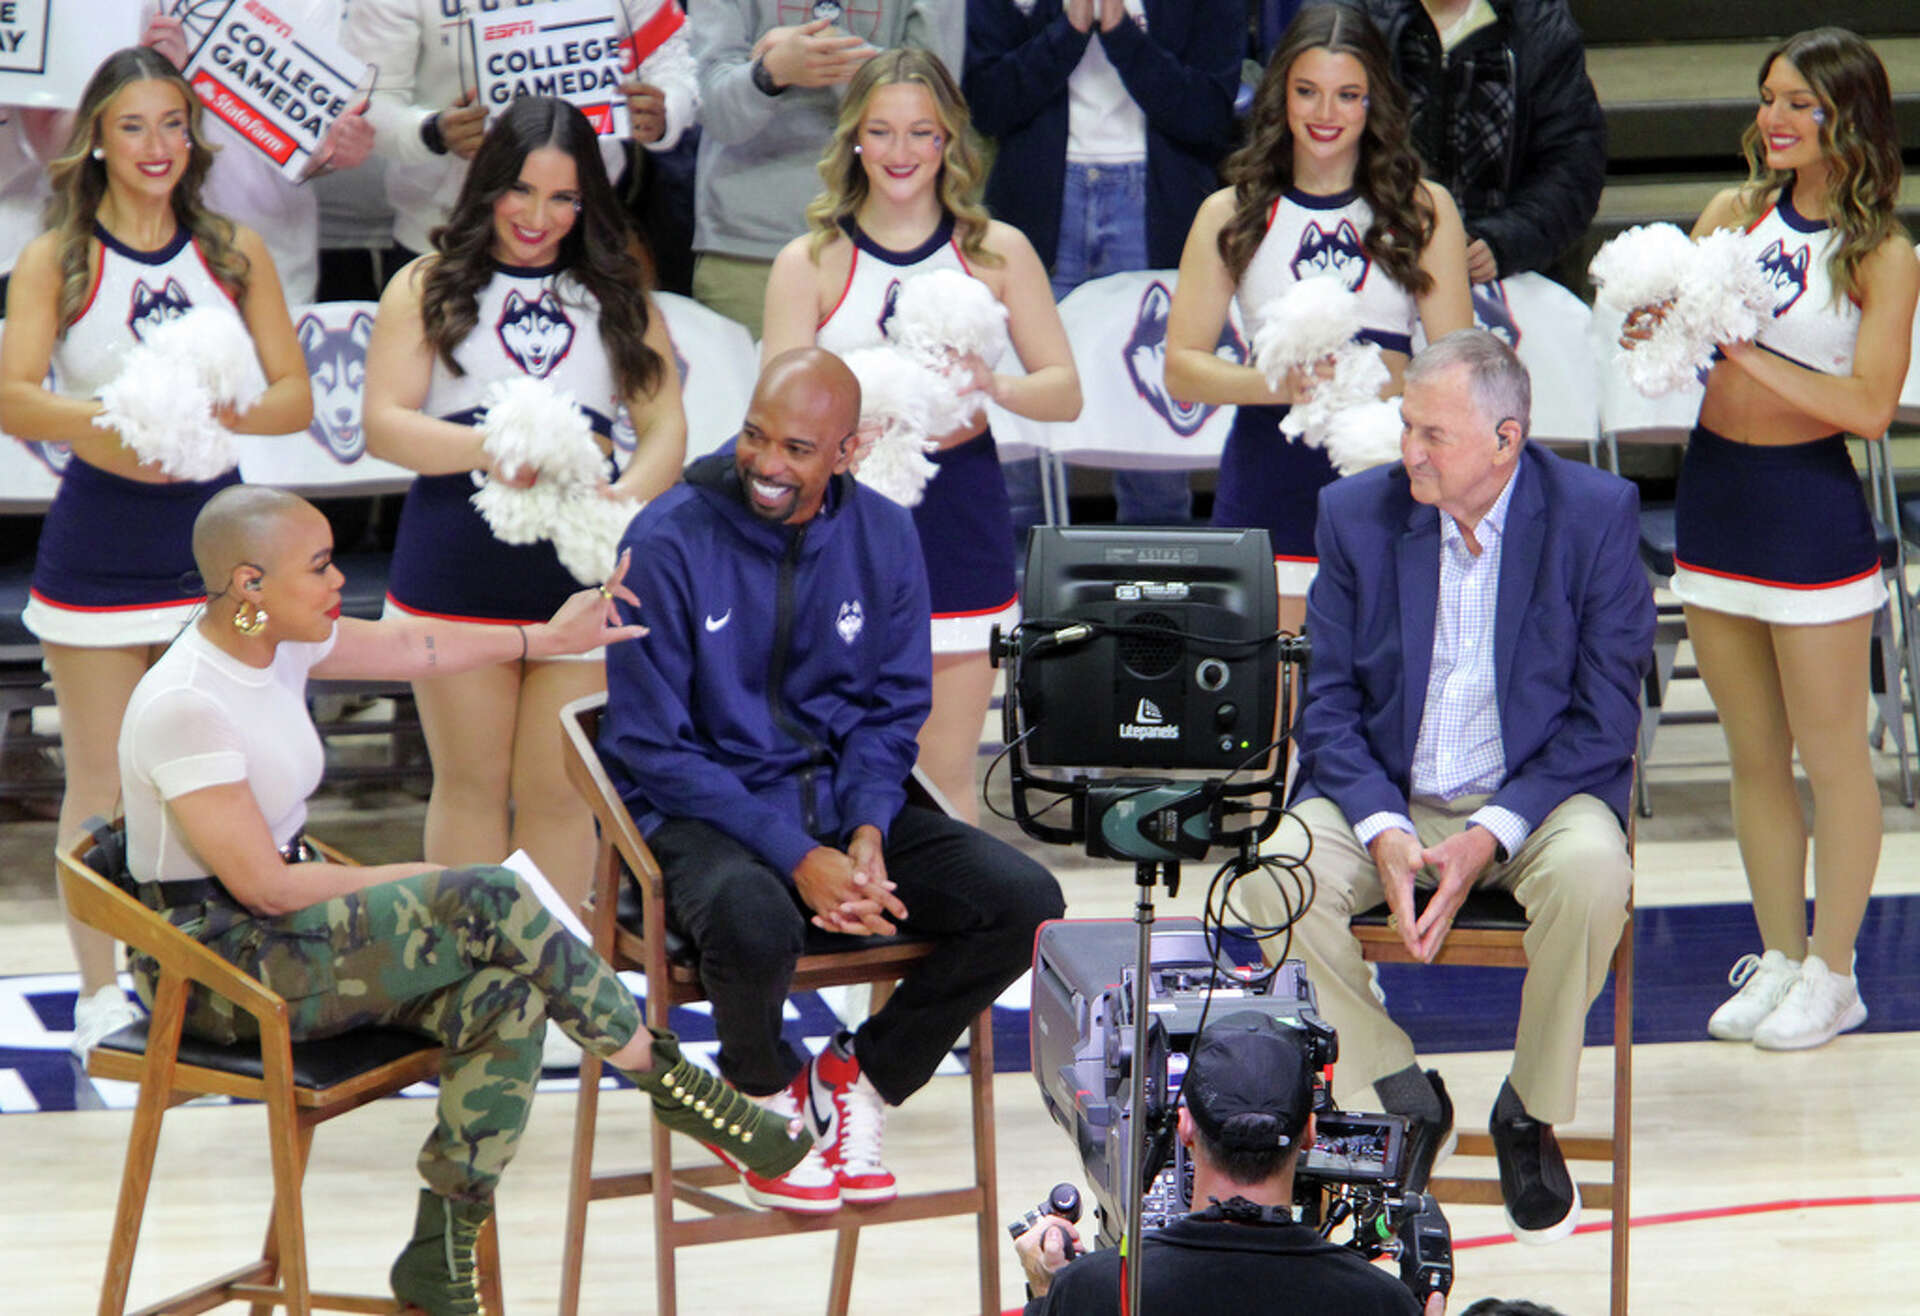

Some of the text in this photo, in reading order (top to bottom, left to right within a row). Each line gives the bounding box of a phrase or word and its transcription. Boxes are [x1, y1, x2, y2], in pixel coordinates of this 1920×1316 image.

[243, 0, 294, 39] ESPN
[483, 20, 535, 41] ESPN
[227, 22, 347, 119] COLLEGE
[488, 36, 621, 76] COLLEGE
[212, 44, 333, 138] GAMEDA
[490, 65, 624, 104] GAMEDA
